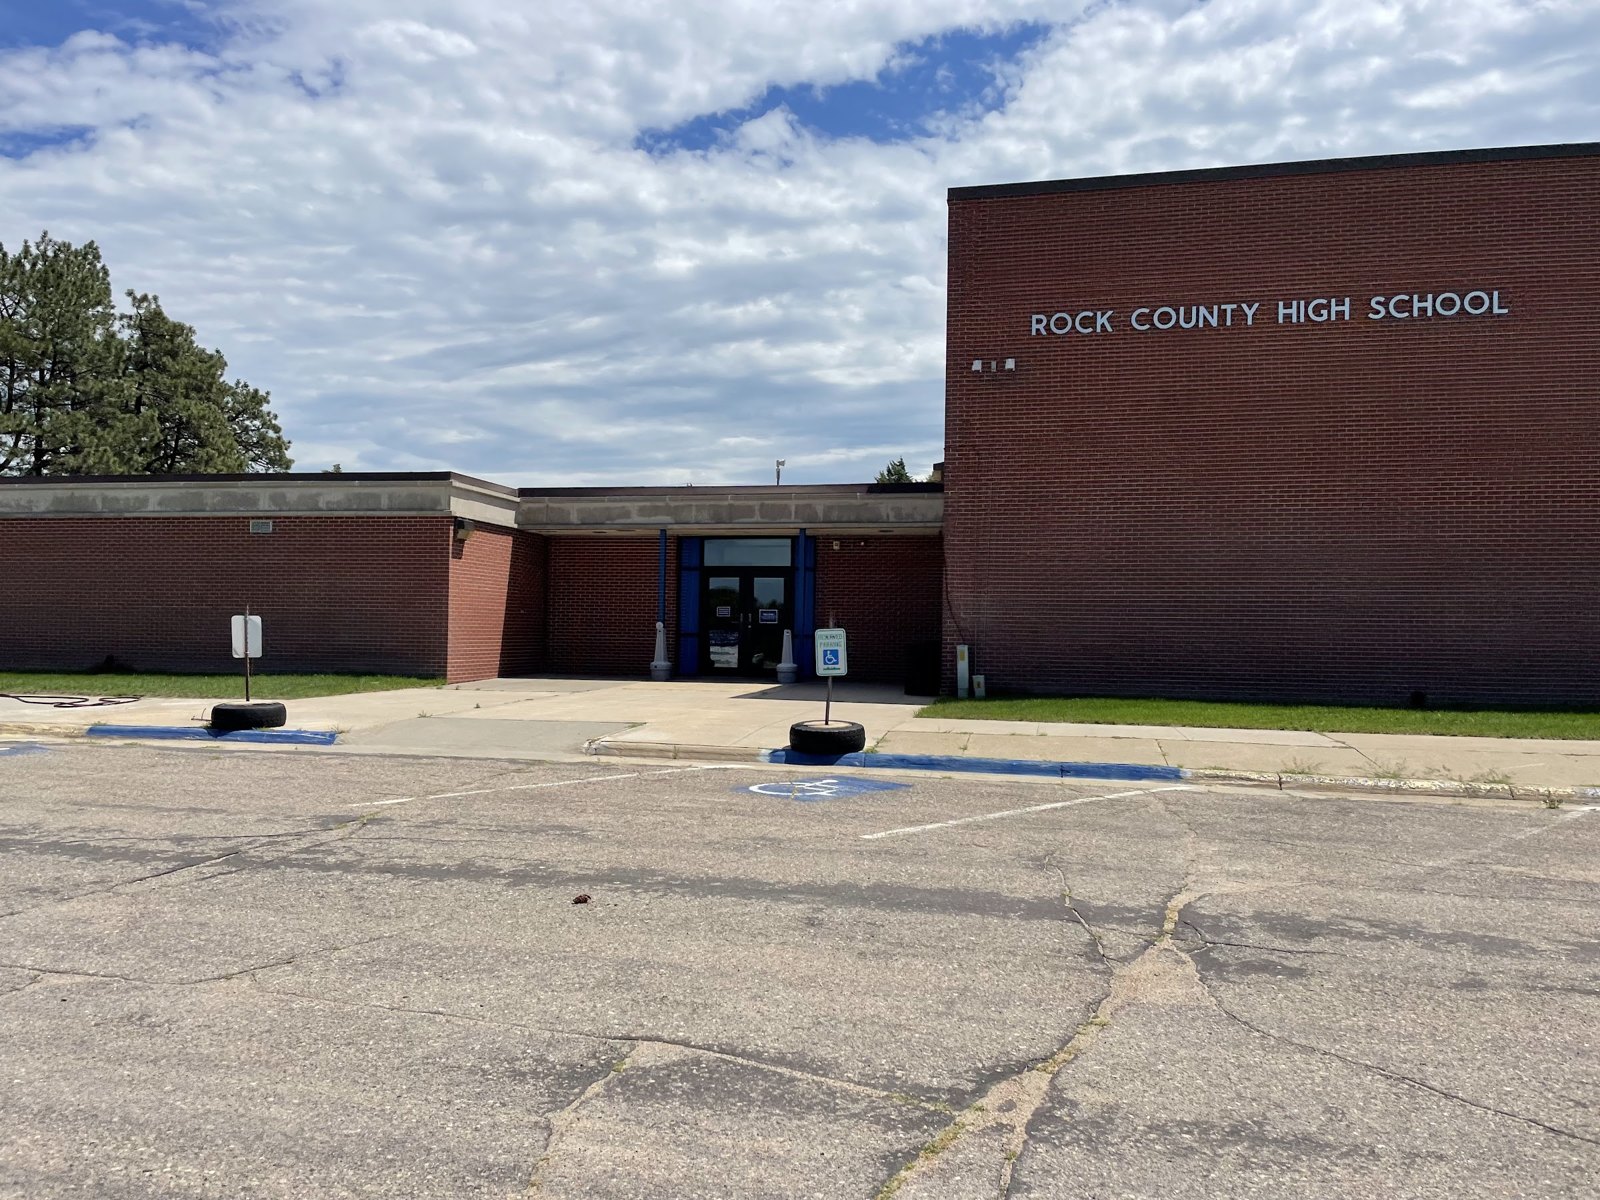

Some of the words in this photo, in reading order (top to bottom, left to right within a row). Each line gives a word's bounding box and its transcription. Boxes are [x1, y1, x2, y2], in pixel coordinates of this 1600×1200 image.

[1031, 310, 1114, 336] ROCK
[1130, 302, 1260, 331] COUNTY
[1278, 297, 1350, 324] HIGH
[1367, 290, 1509, 320] SCHOOL
